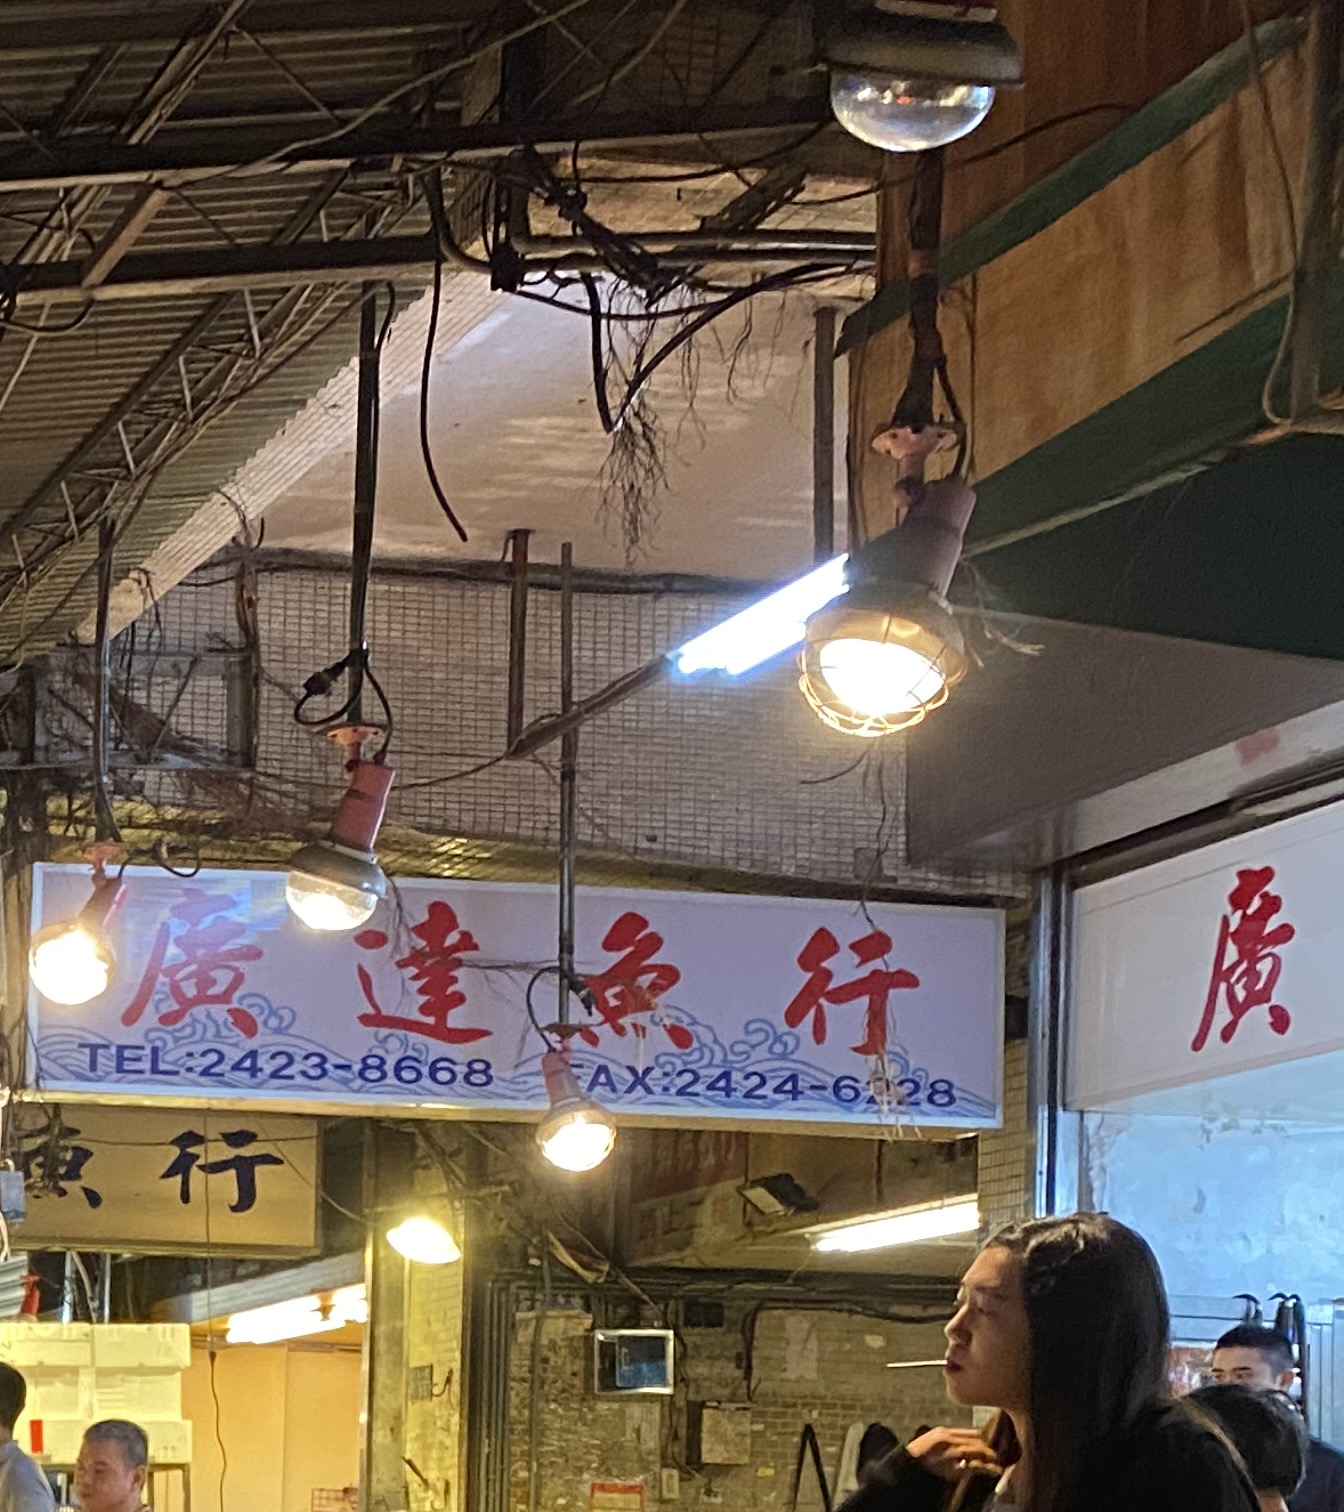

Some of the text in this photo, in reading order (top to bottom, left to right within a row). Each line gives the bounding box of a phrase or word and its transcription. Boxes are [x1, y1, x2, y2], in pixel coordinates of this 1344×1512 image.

[121, 885, 921, 1055] 廣達魚行
[1191, 865, 1296, 1053] 廣
[77, 1042, 494, 1088] TEL:2423-8668
[569, 1062, 958, 1108] AX:2424-628
